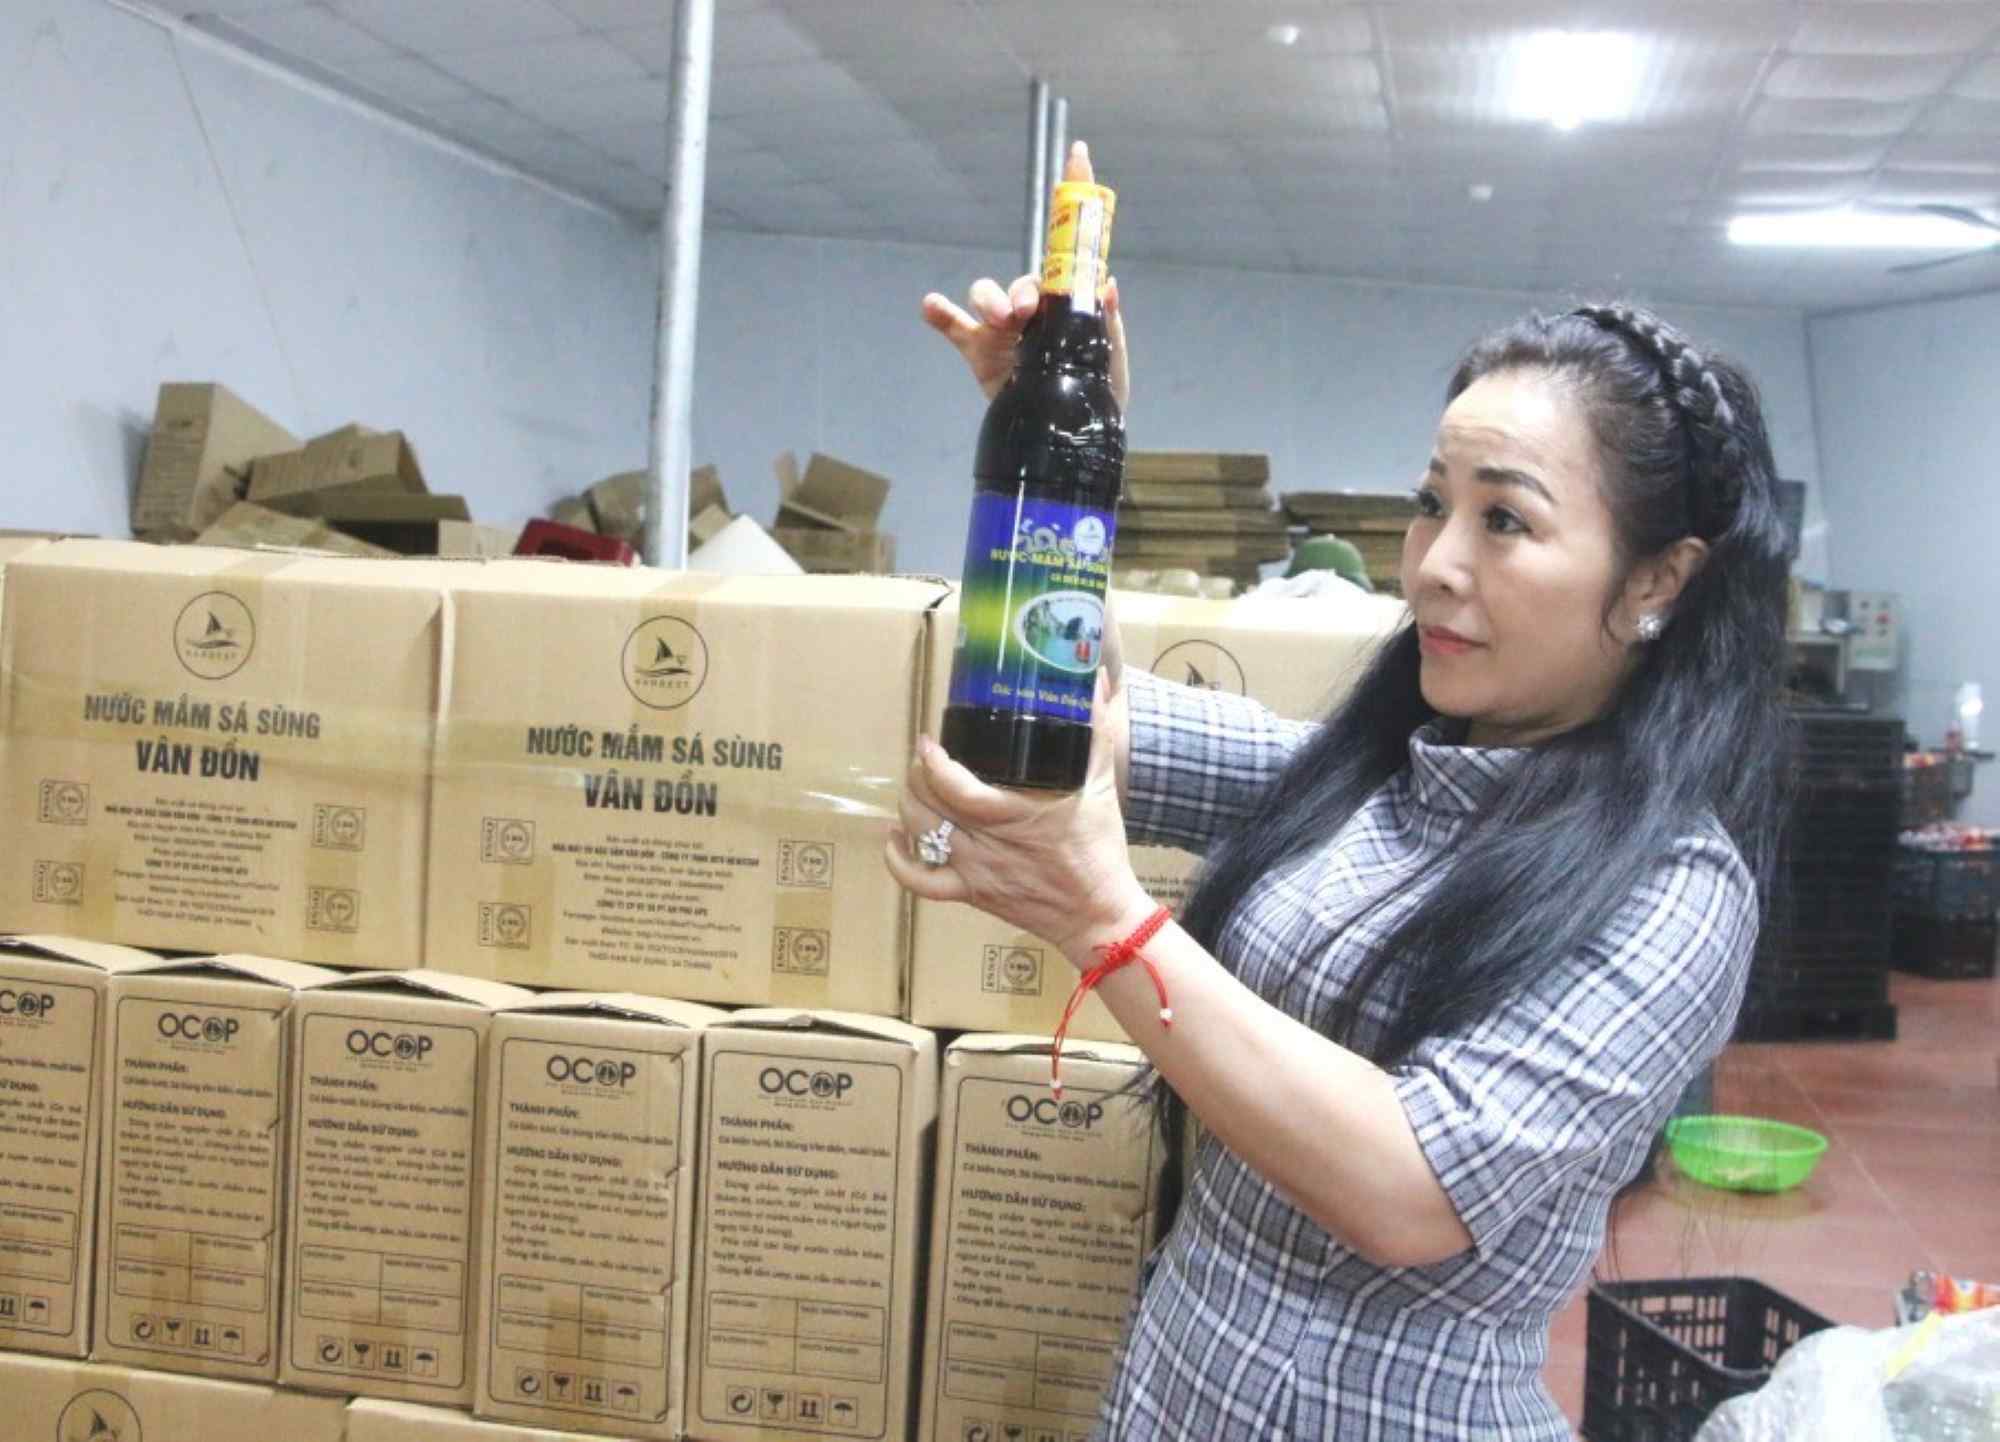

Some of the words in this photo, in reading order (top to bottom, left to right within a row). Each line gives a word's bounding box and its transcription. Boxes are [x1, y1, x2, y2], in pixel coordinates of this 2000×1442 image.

[85, 692, 145, 724] NƯỚC
[153, 693, 211, 730] MẮM
[218, 700, 249, 734] SÁ
[257, 703, 321, 740] SÙNG
[136, 734, 191, 777] VÂN
[200, 738, 260, 782] ĐỒN
[527, 725, 595, 759] NƯỚC
[601, 723, 664, 763] MẮM
[671, 731, 705, 766] SÁ
[712, 735, 784, 771] SÙNG
[583, 769, 644, 812] VÂN
[652, 769, 719, 818] ĐỒN
[158, 1011, 239, 1043] OCOP
[346, 1028, 432, 1061] OCOP
[546, 1053, 635, 1088] OCOP
[758, 1066, 852, 1099] OCOP
[1007, 1093, 1103, 1131] OCOP
